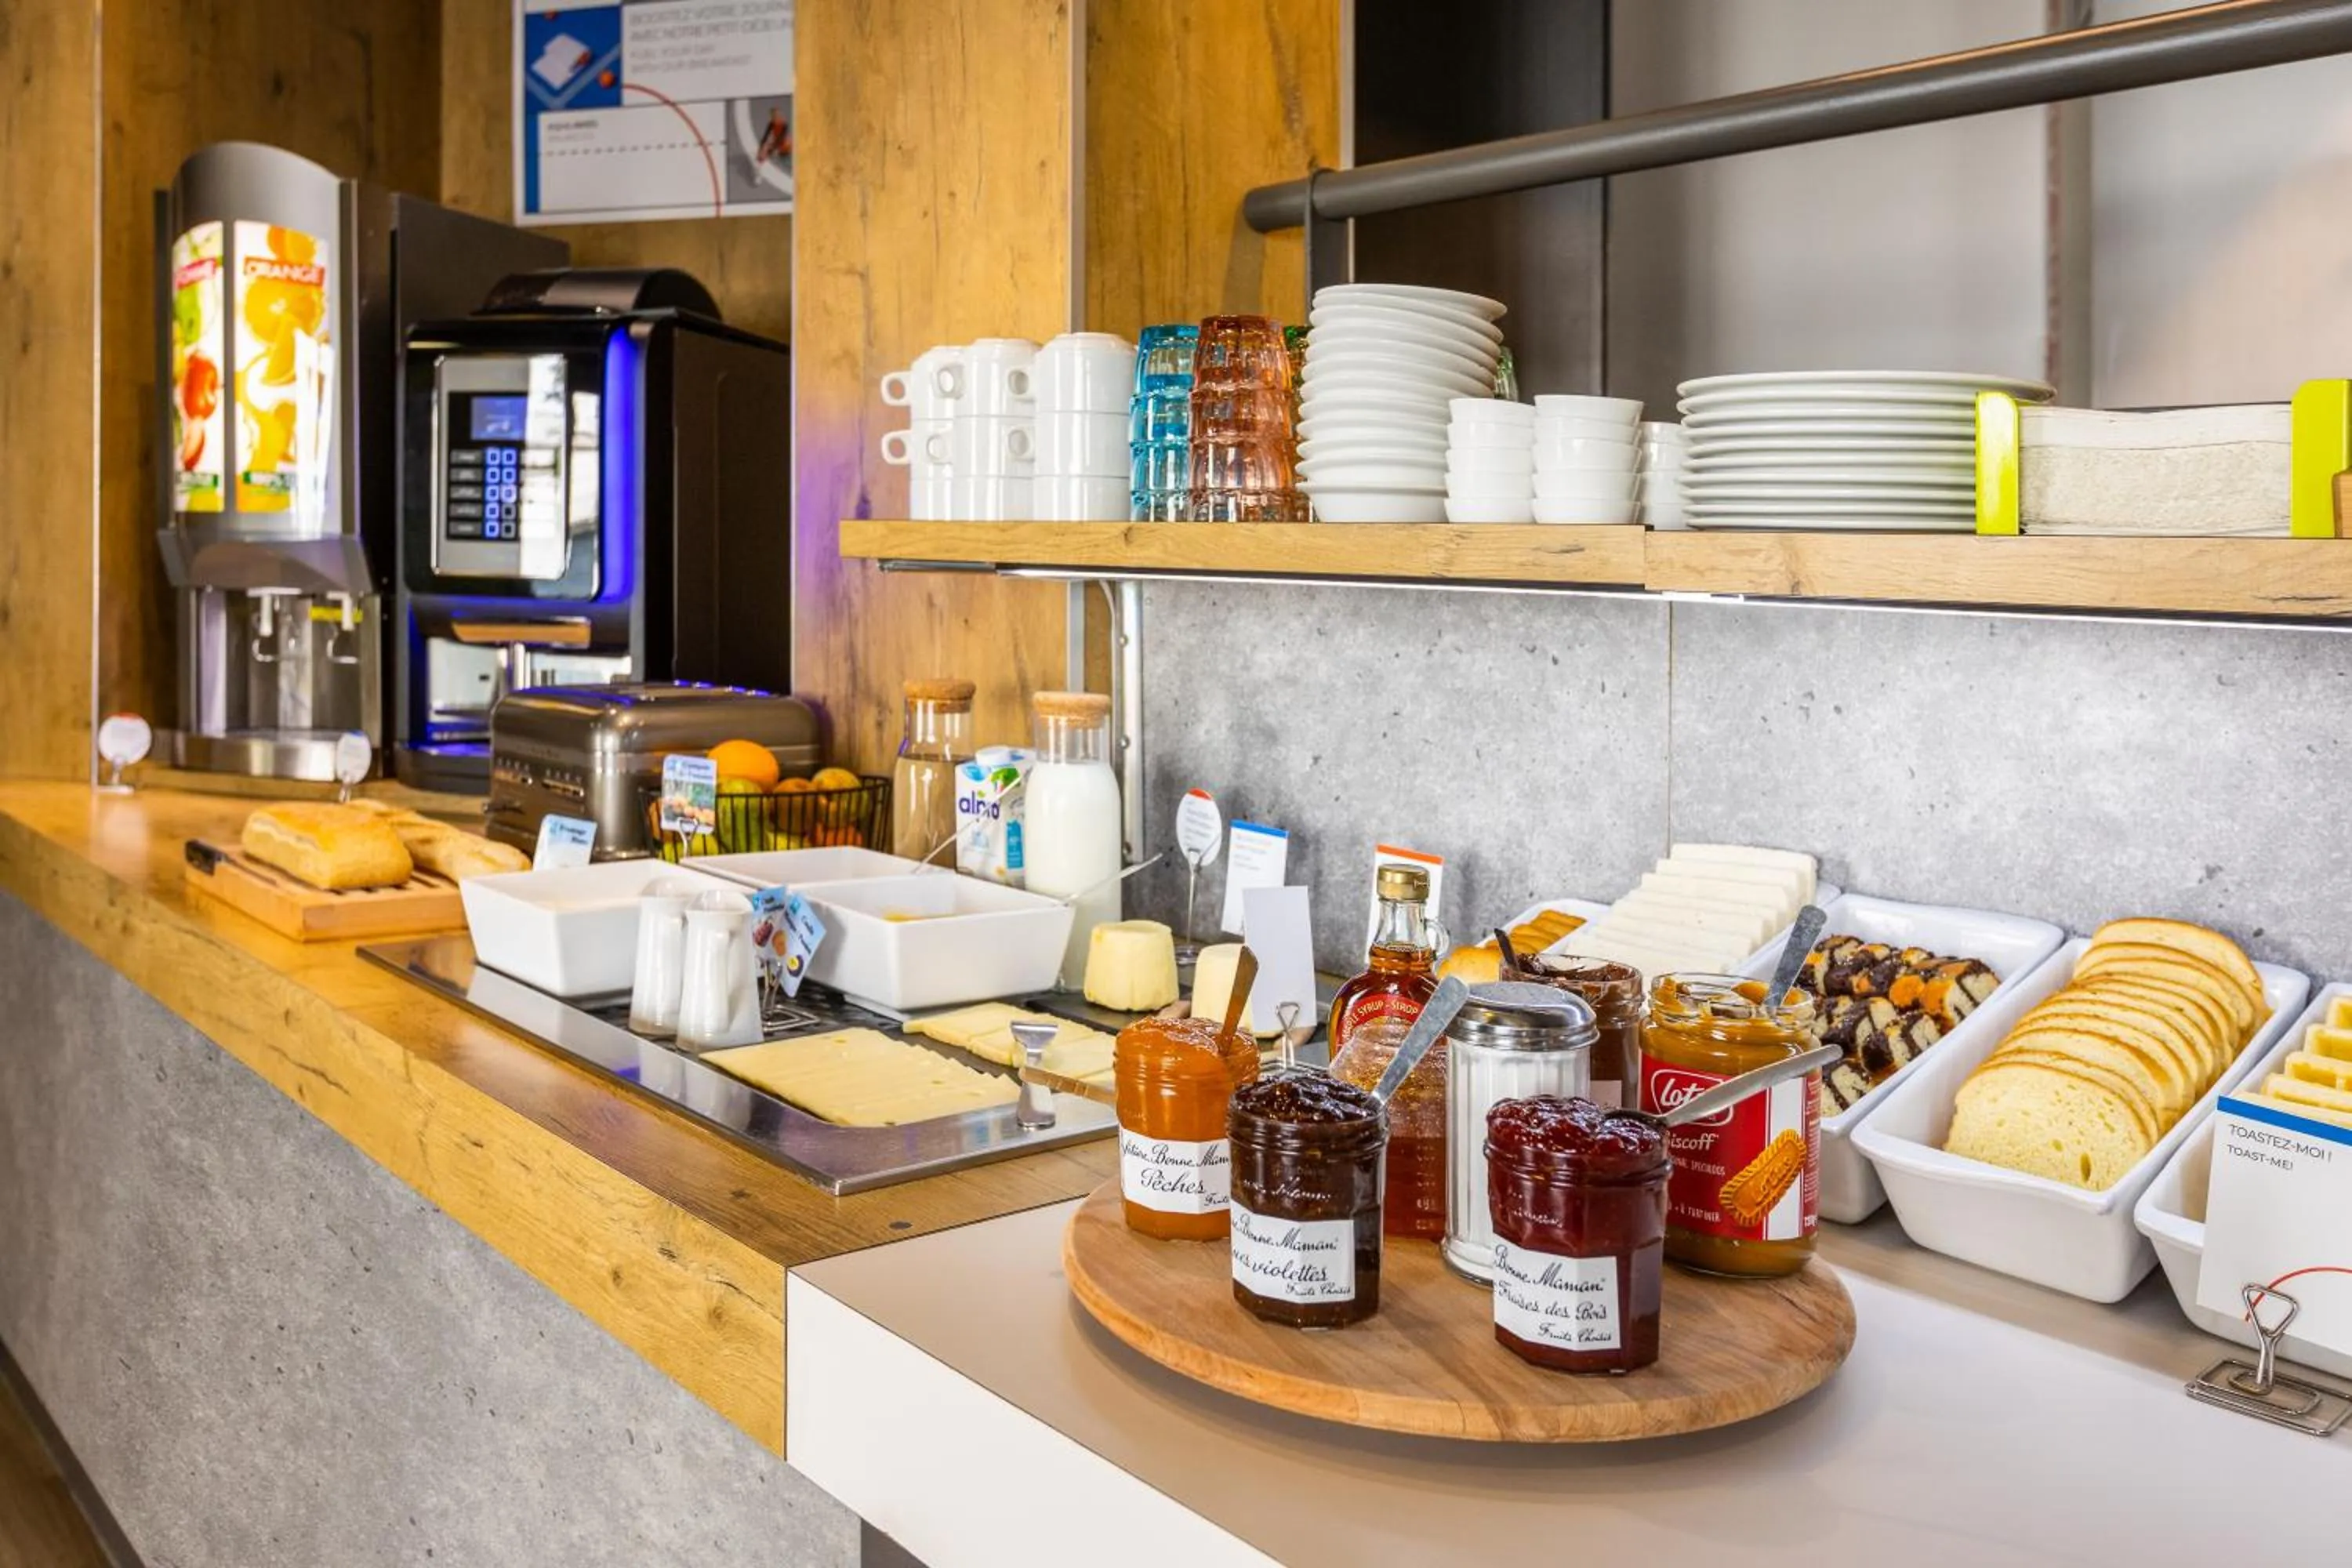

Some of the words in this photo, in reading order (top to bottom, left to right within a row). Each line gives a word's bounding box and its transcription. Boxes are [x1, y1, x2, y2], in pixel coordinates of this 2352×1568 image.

[245, 260, 321, 284] ORANGE
[958, 790, 1001, 822] alpo
[1357, 1000, 1384, 1017] SYRUP
[1391, 1000, 1418, 1015] SIROP
[1660, 1078, 1705, 1107] Lot
[1151, 1144, 1195, 1167] Bonne
[1196, 1143, 1230, 1167] Mam
[2227, 1123, 2325, 1160] TOASTEZ-MOI
[2226, 1144, 2294, 1171] TOAST-ME!
[1141, 1167, 1206, 1194] Pêches
[1276, 1226, 1338, 1252] Maman
[1250, 1259, 1329, 1282] violettes
[1494, 1244, 1531, 1283] Bonne
[1533, 1261, 1605, 1293] Maman
[1497, 1279, 1540, 1313] Fraises
[1544, 1301, 1570, 1319] des
[1537, 1322, 1572, 1341] Fruits
